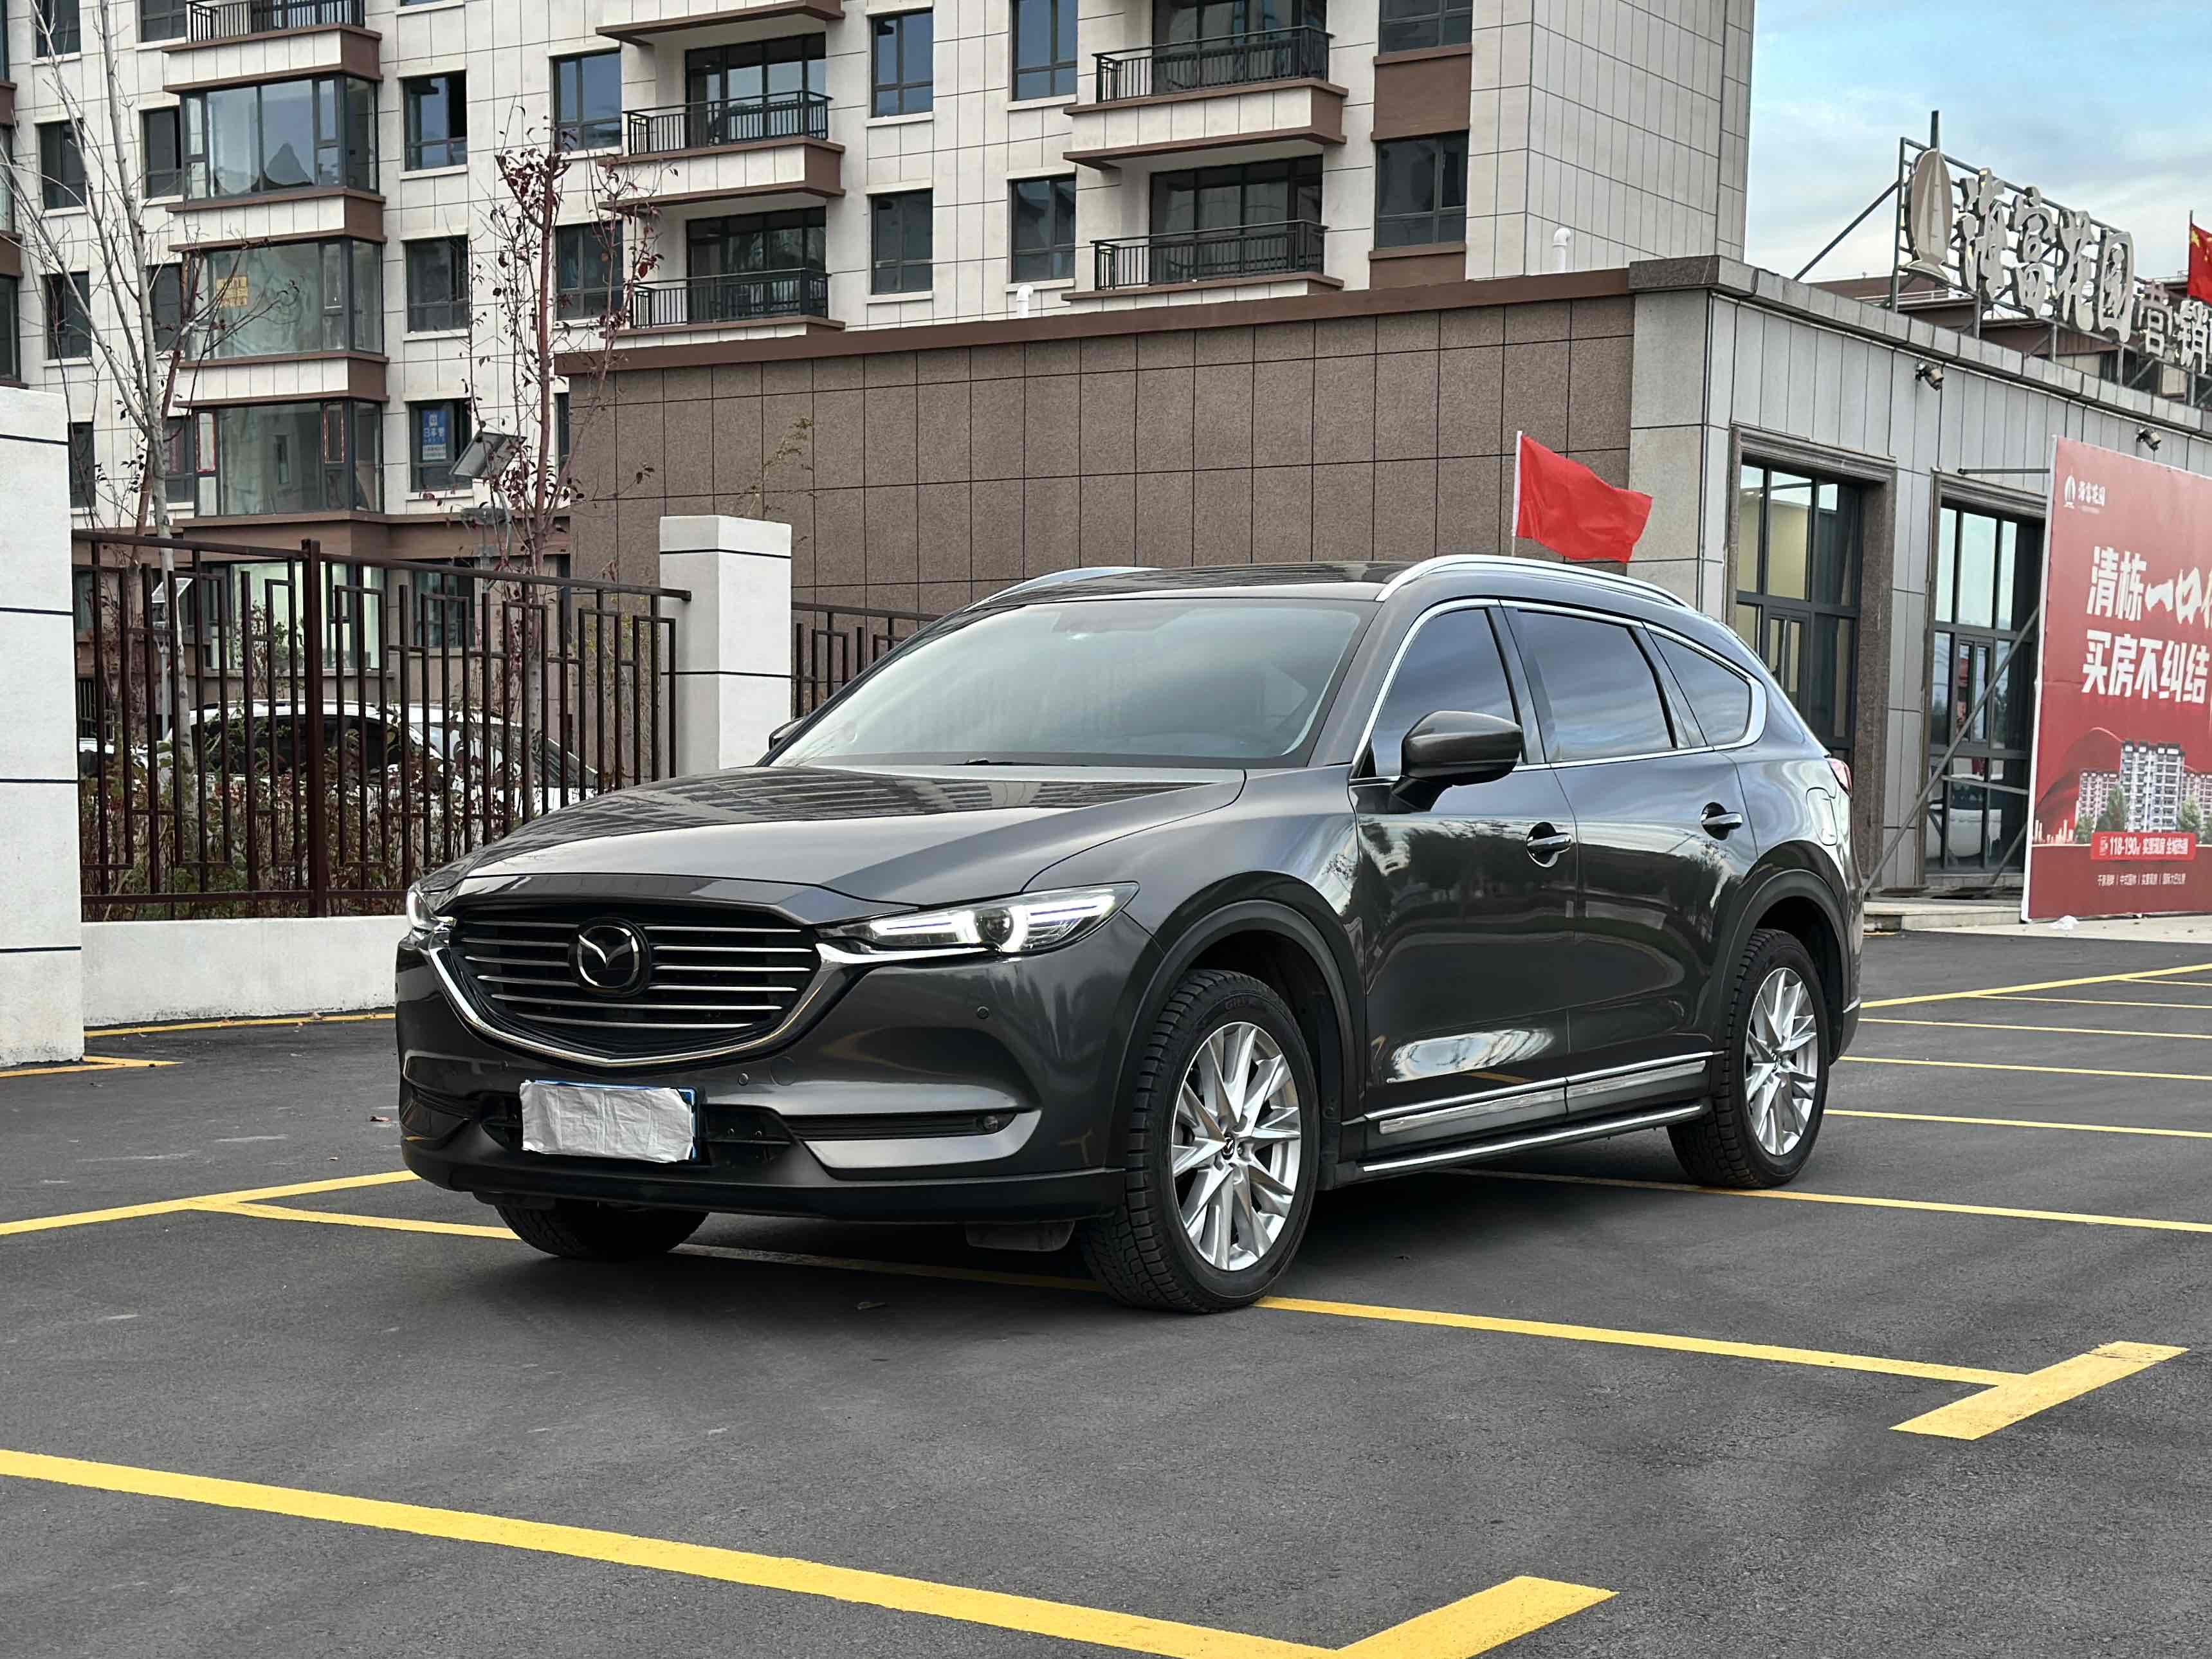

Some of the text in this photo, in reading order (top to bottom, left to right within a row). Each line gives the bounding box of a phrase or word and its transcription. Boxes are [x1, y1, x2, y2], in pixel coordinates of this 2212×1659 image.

[2138, 280, 2212, 374] 营销
[2081, 629, 2210, 704] 买房不纠结
